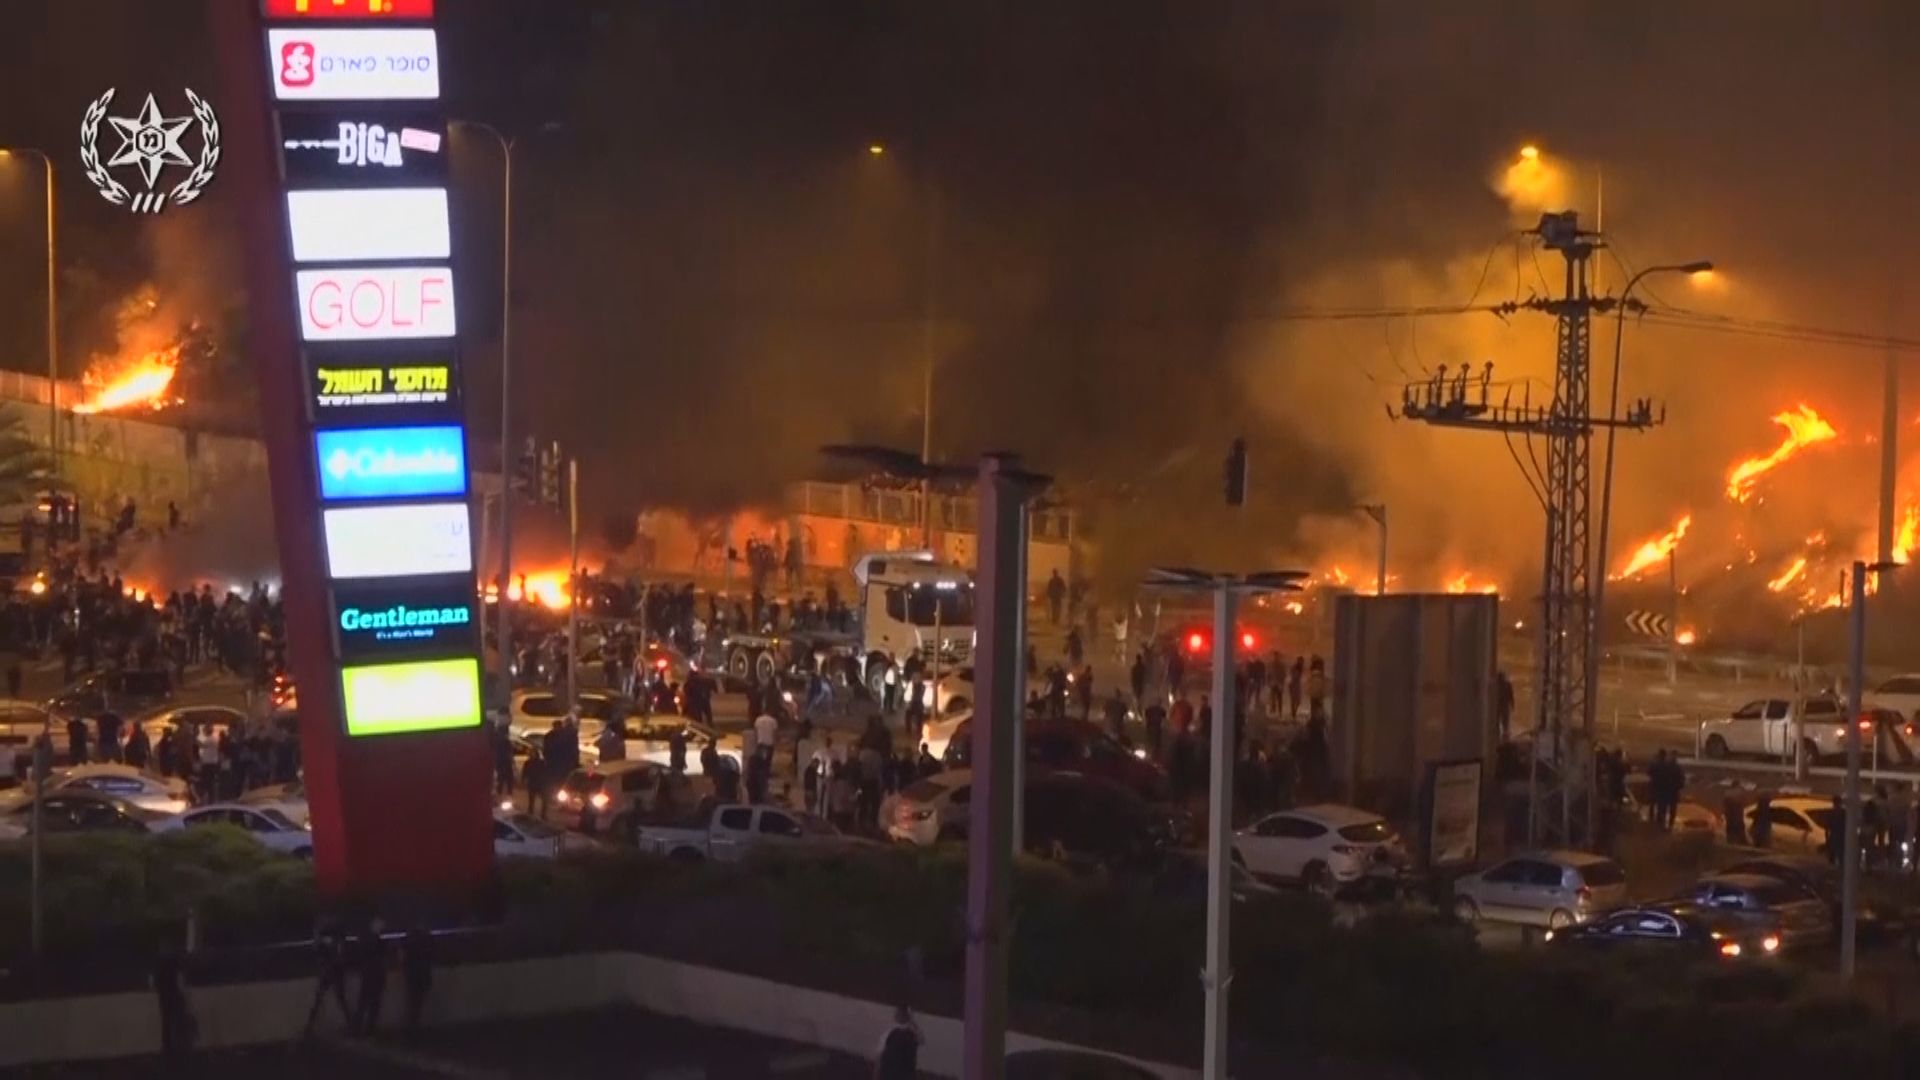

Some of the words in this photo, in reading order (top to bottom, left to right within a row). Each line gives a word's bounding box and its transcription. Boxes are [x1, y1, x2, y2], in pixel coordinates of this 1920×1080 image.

[320, 56, 376, 72] פארם
[386, 56, 430, 72] סופר
[337, 121, 403, 167] BIGA
[309, 279, 445, 329] GOLF
[317, 367, 383, 394] חשמל
[388, 366, 448, 392] מחסני
[340, 605, 469, 630] Gentleman
